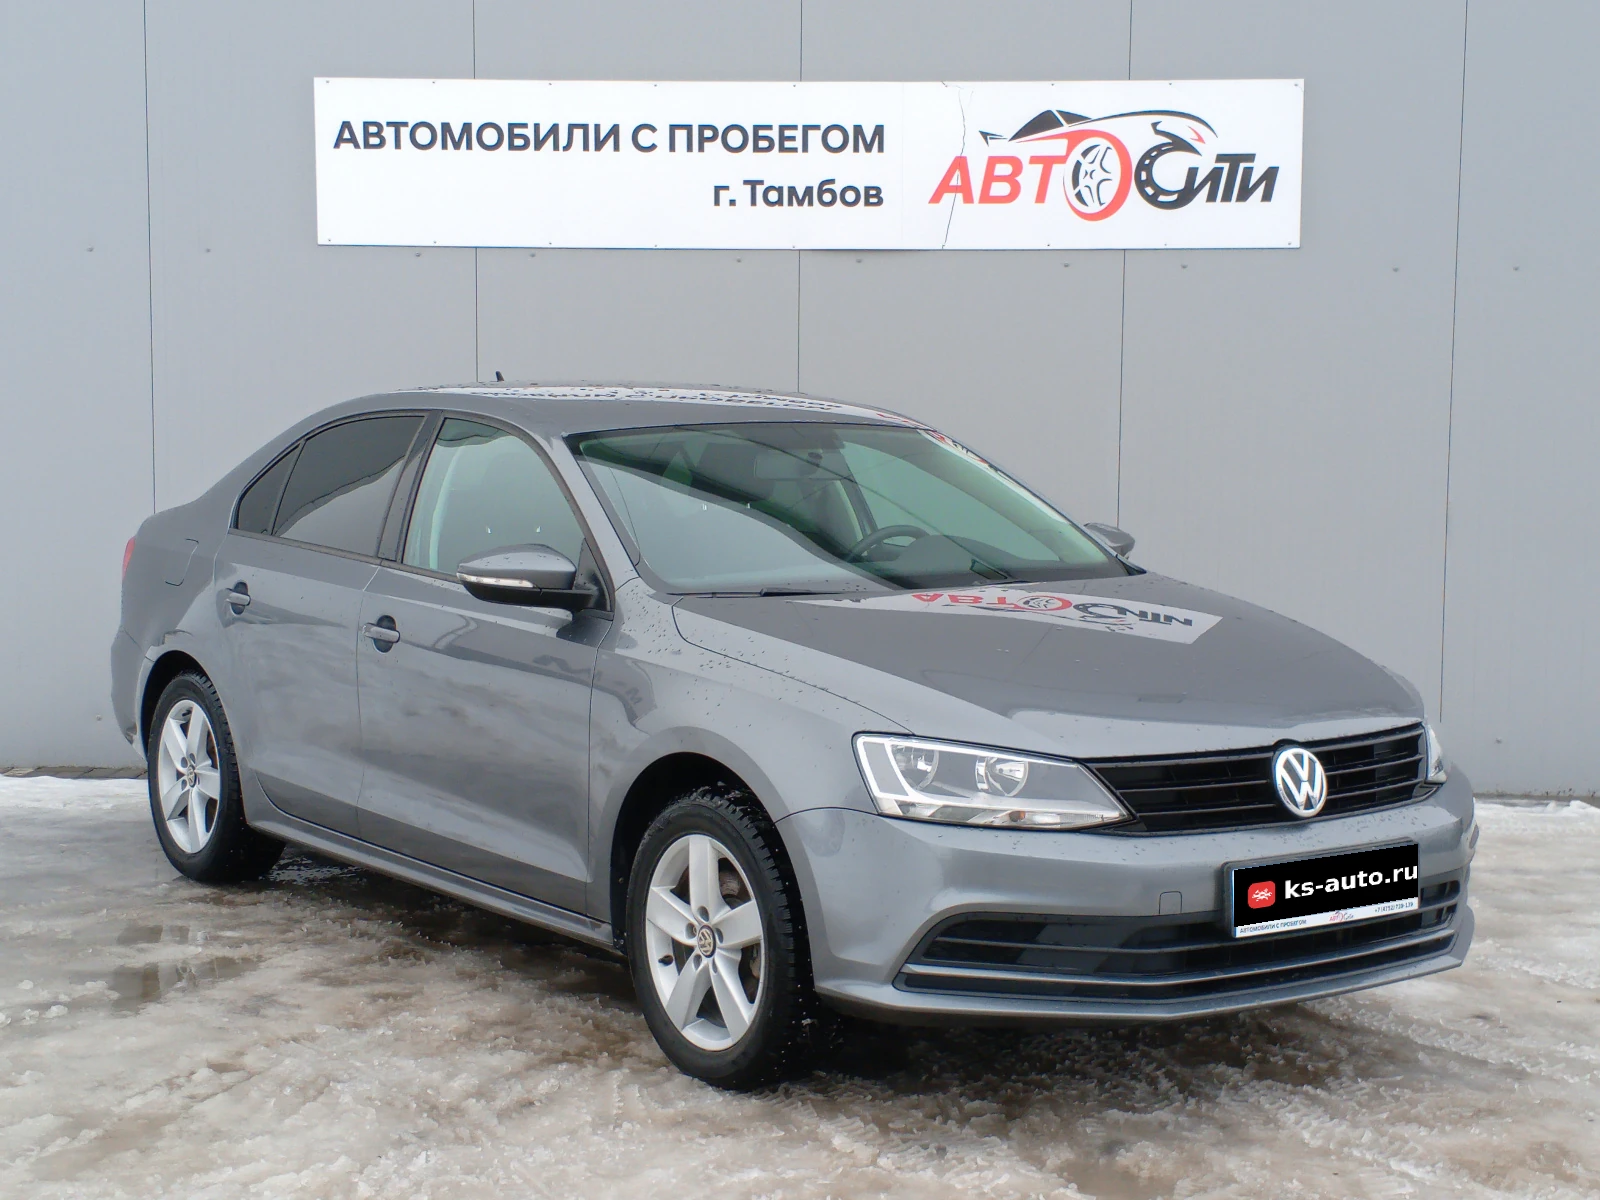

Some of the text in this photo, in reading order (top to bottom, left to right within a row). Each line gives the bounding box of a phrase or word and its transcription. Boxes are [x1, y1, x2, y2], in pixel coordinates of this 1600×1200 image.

[333, 120, 885, 154] АВТОМОБИЛИ С ПРОБЕГОМ
[713, 178, 884, 208] г. Тамбов
